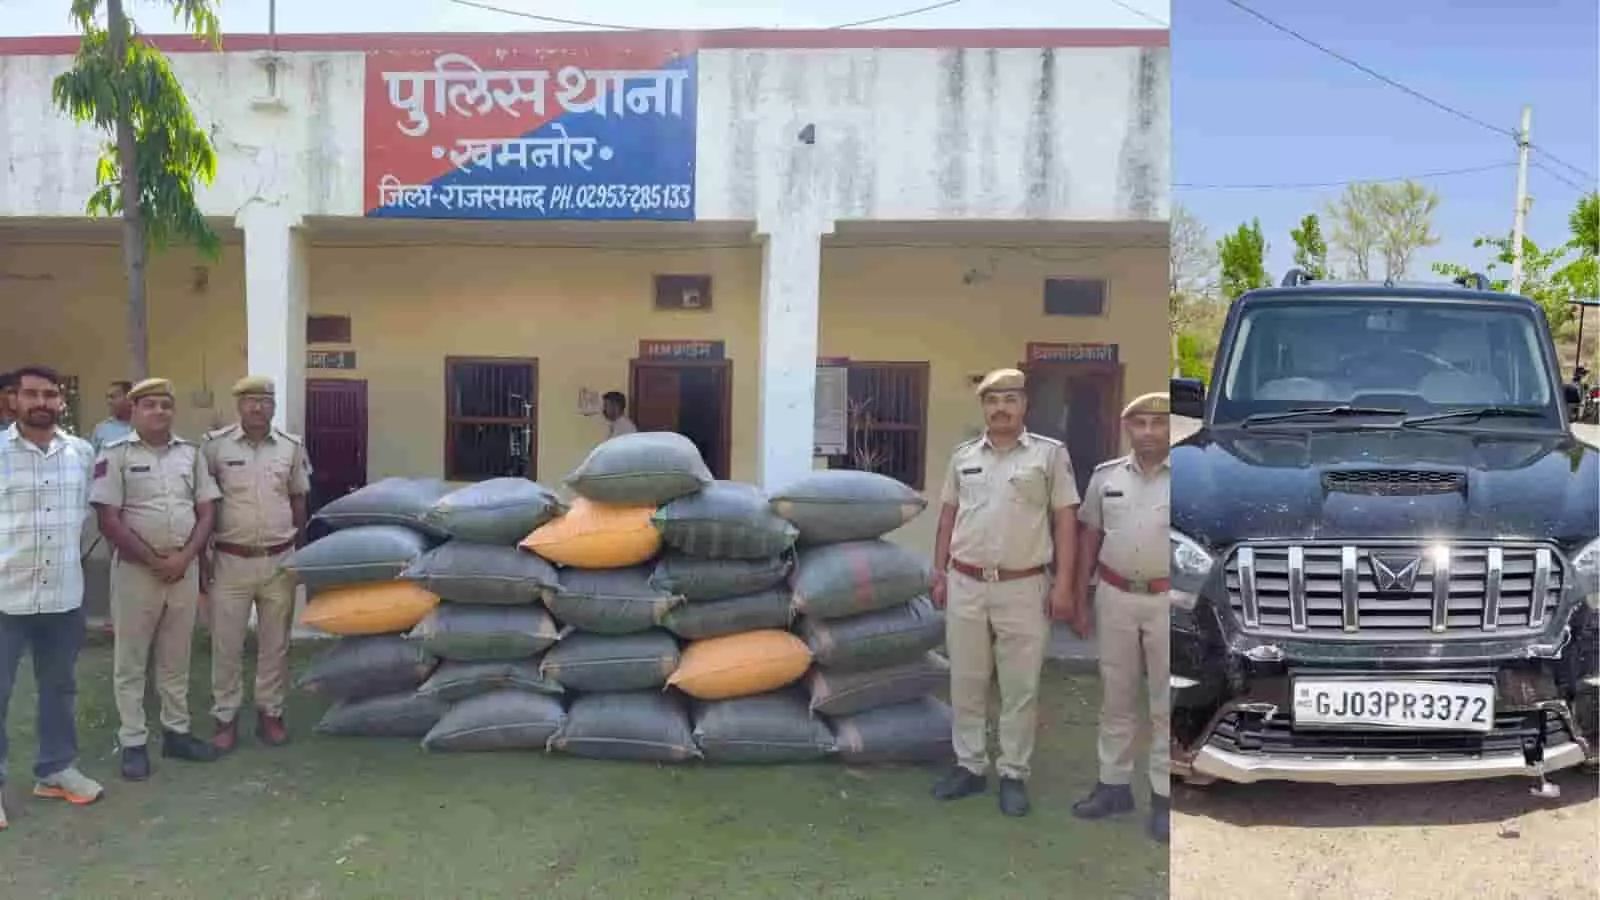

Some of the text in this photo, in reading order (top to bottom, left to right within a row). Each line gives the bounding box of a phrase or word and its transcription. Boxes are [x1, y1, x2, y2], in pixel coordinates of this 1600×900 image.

[382, 53, 689, 136] पुलिस थाना
[450, 123, 597, 172] खमनोर
[1316, 691, 1488, 723] GJ03PR3372
